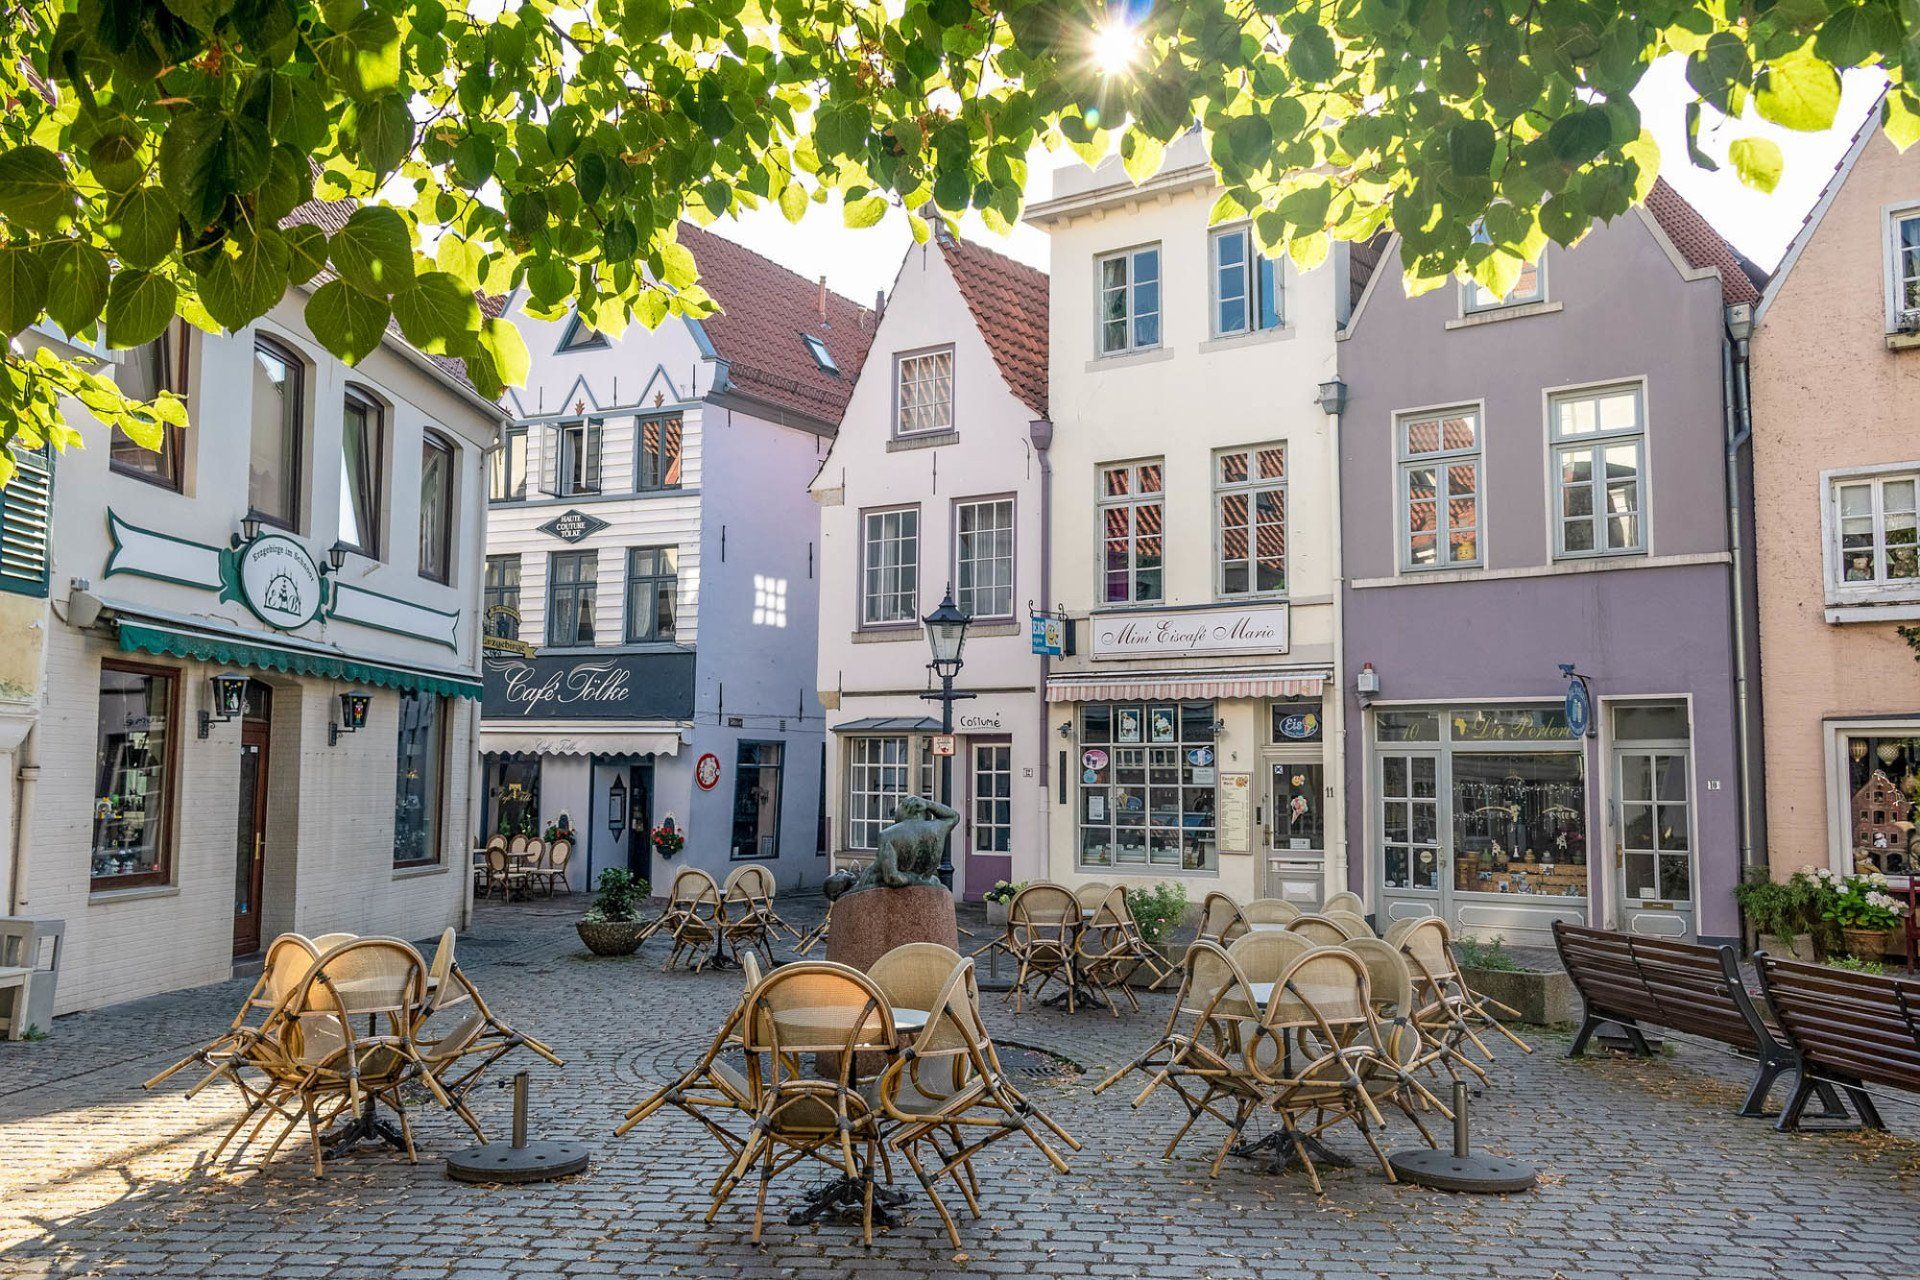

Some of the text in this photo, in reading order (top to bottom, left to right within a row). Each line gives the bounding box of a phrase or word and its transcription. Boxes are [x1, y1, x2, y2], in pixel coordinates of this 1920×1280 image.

[556, 522, 585, 530] COUTURE
[252, 545, 284, 561] Erzgebirge
[285, 547, 293, 557] im
[1032, 620, 1047, 635] EIS
[1101, 616, 1276, 648] Mini Eiscafé Mario
[497, 659, 631, 715] Café Tölke
[1285, 718, 1303, 731] Eis
[1402, 722, 1420, 740] 10
[1473, 714, 1505, 739] Die
[1325, 786, 1334, 798] 11
